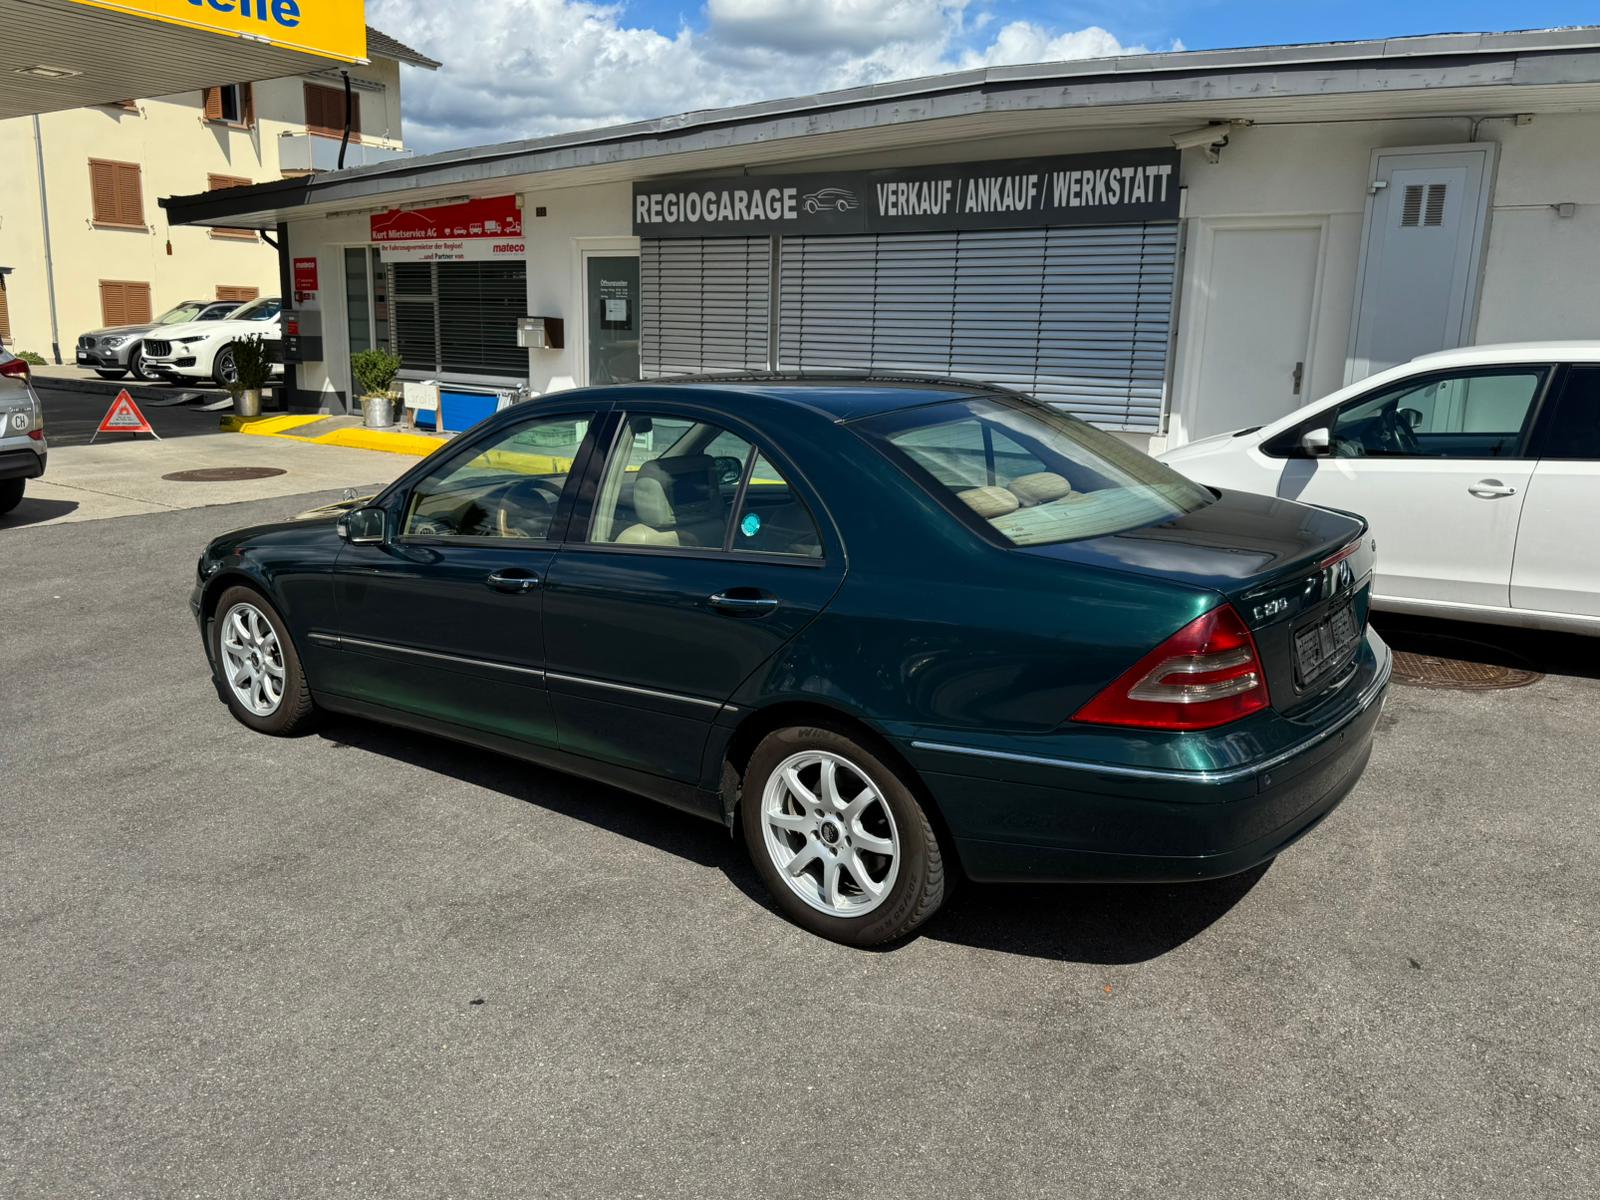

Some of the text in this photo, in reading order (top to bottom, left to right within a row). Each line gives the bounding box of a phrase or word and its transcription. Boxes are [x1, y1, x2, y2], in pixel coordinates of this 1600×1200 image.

[876, 180, 952, 217] VERKAUF
[964, 174, 1038, 214] ANKAUF
[1053, 164, 1172, 208] WERKSTATT
[636, 187, 798, 224] REGIOGARAGE
[372, 227, 437, 239] Kurt Mietservice AG
[492, 242, 526, 253] mateco
[434, 252, 454, 260] Partner
[15, 415, 26, 428] CH
